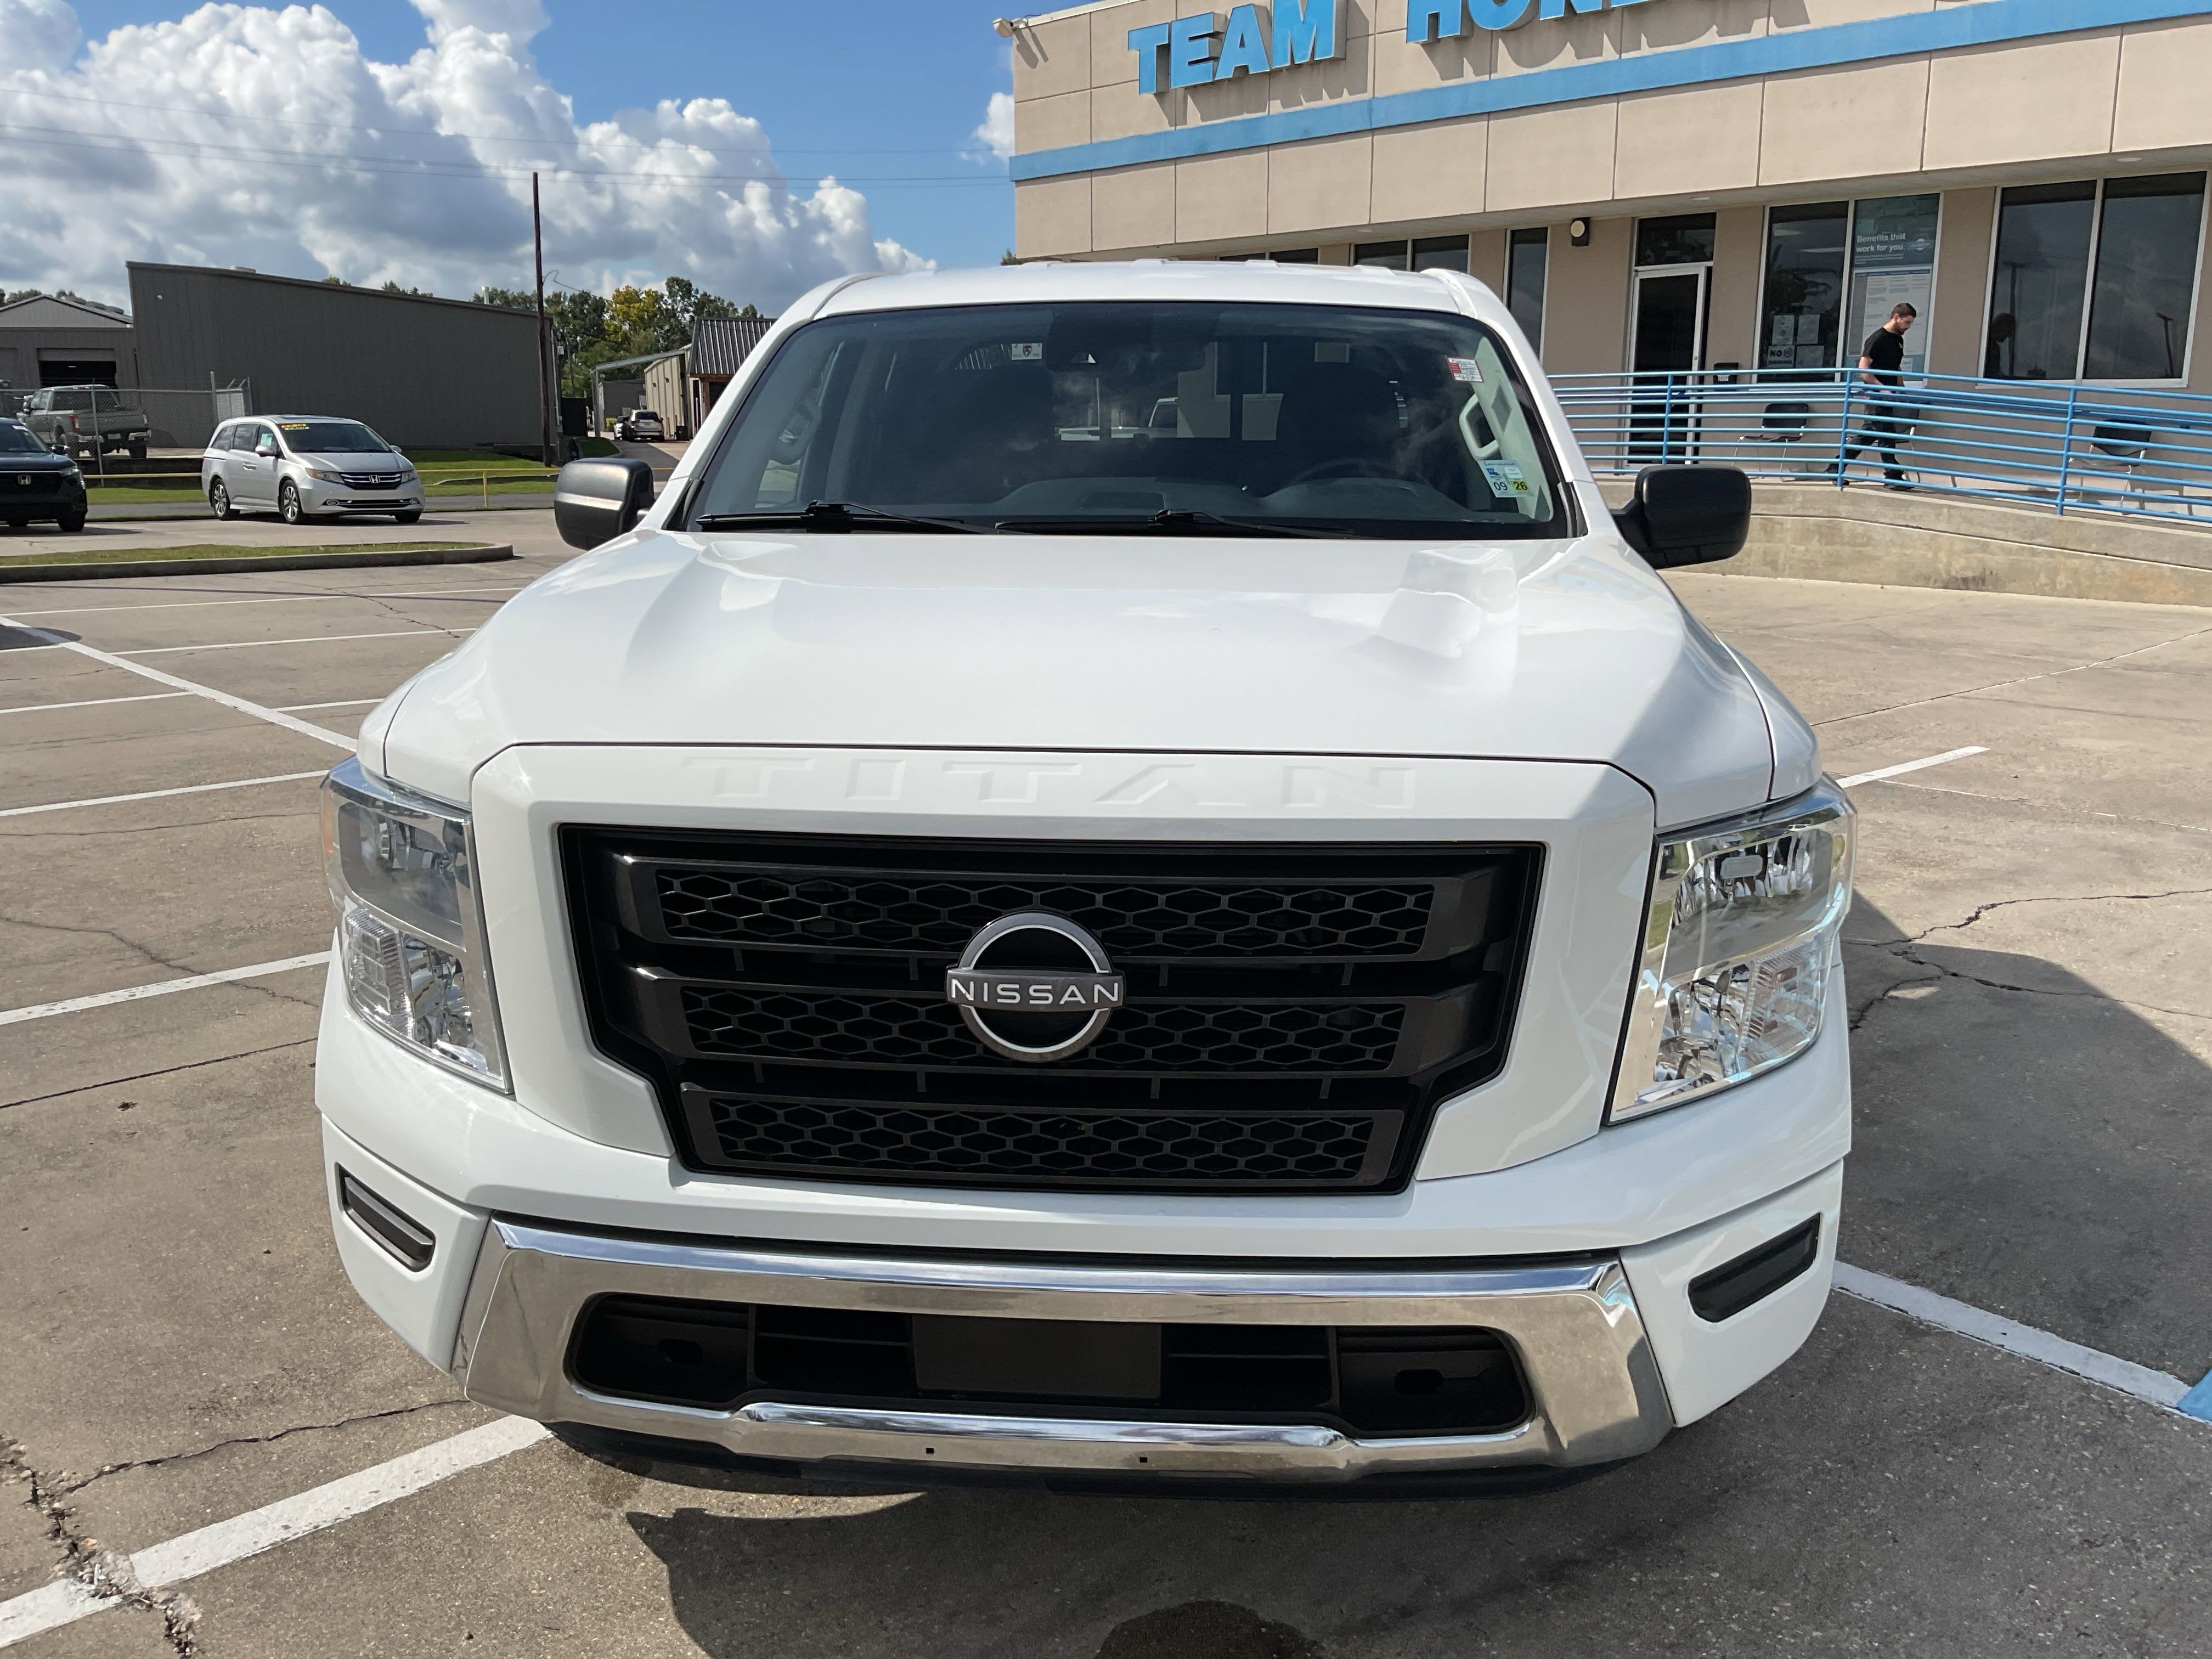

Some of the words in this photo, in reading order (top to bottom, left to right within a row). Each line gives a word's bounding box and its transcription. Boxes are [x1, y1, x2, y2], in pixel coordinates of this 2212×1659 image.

[1127, 0, 1335, 95] TEAM
[1857, 234, 1888, 242] Benefits
[1856, 245, 1875, 253] work
[1493, 482, 1508, 490] 09
[1513, 482, 1528, 490] 26
[680, 755, 1418, 810] TITAN
[951, 978, 1119, 1005] NISSAN
